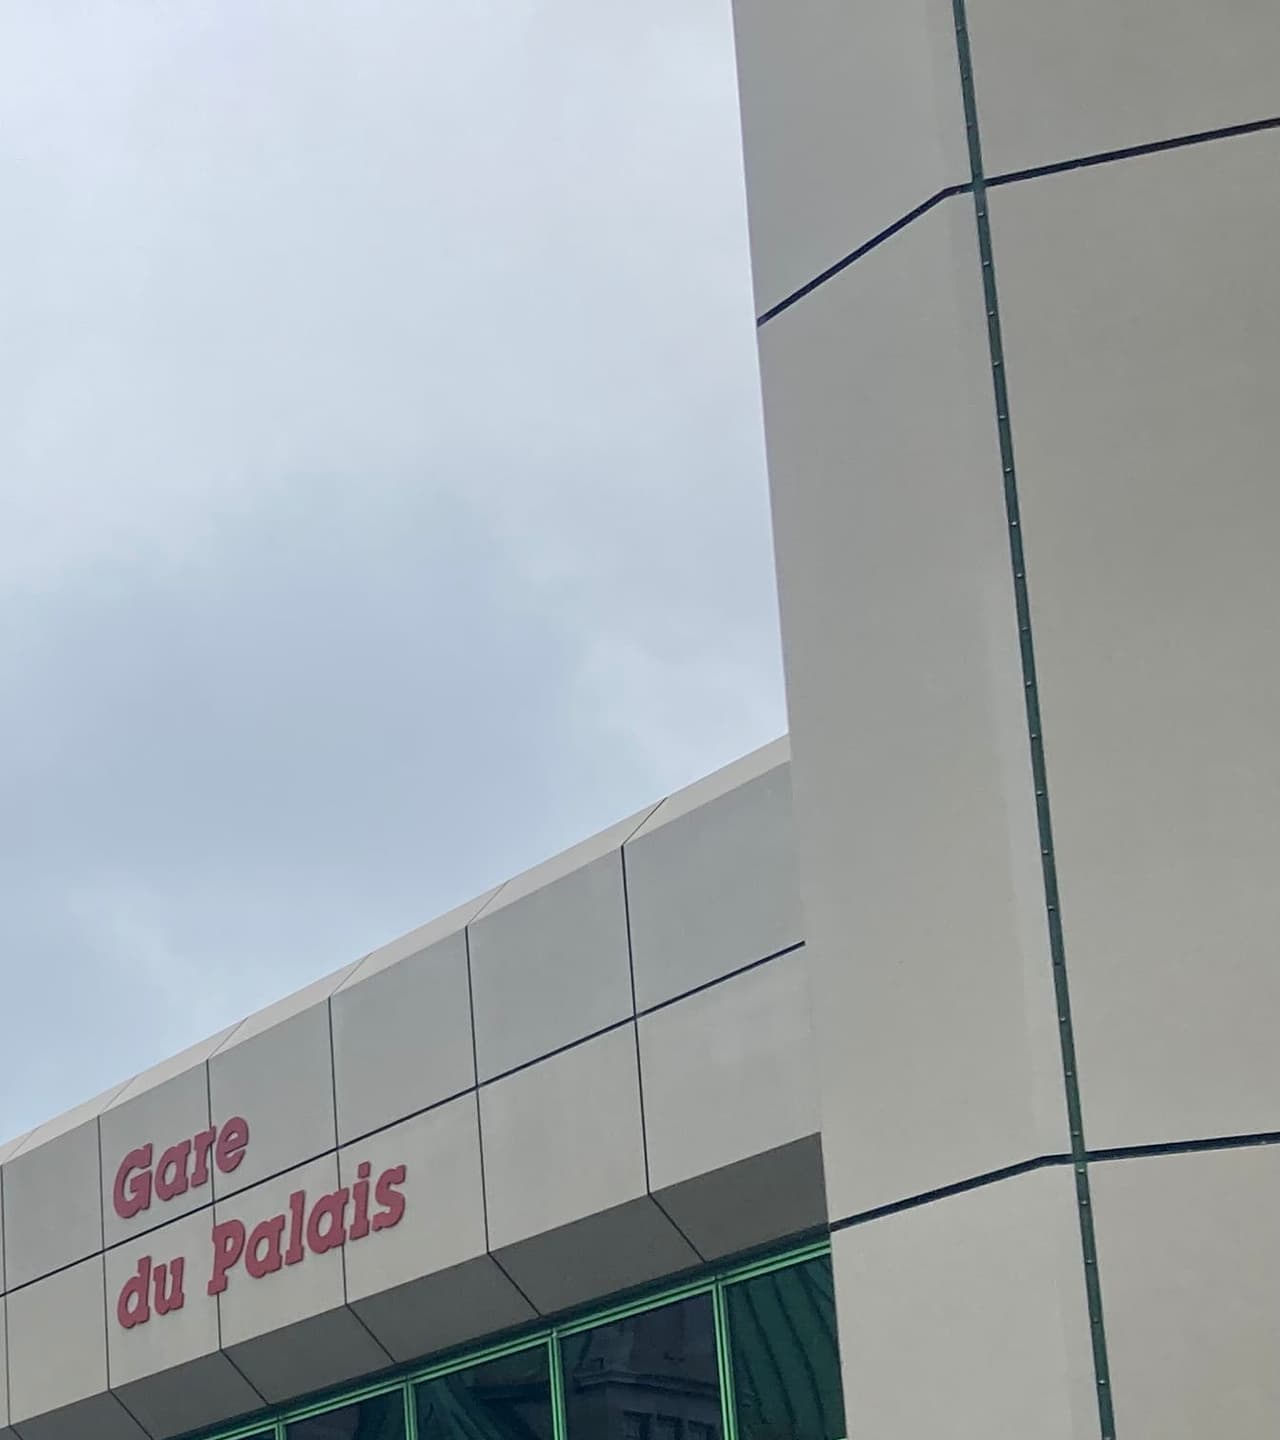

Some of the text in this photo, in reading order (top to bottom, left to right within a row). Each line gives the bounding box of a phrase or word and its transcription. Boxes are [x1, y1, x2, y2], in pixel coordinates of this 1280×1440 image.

[113, 1116, 249, 1219] Gare
[117, 1161, 407, 1329] du Palais
